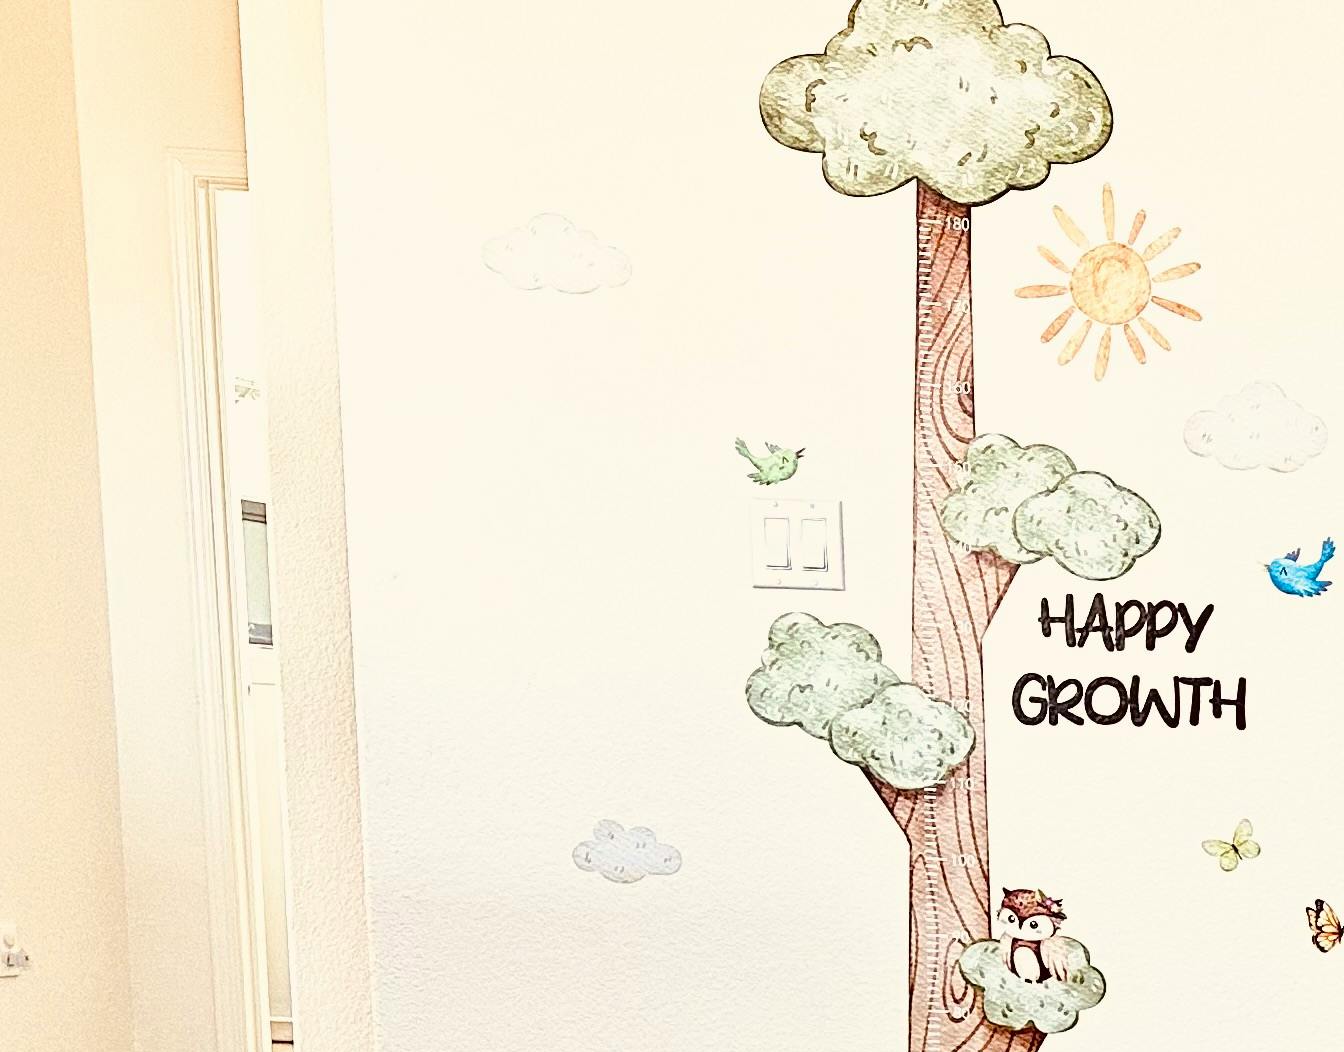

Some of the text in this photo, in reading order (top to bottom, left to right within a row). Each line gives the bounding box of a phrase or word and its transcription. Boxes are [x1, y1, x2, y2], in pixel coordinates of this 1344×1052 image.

[945, 217, 969, 231] 180
[1038, 593, 1214, 653] HAPPY
[1011, 672, 1247, 730] GROWTH
[951, 854, 974, 867] 100
